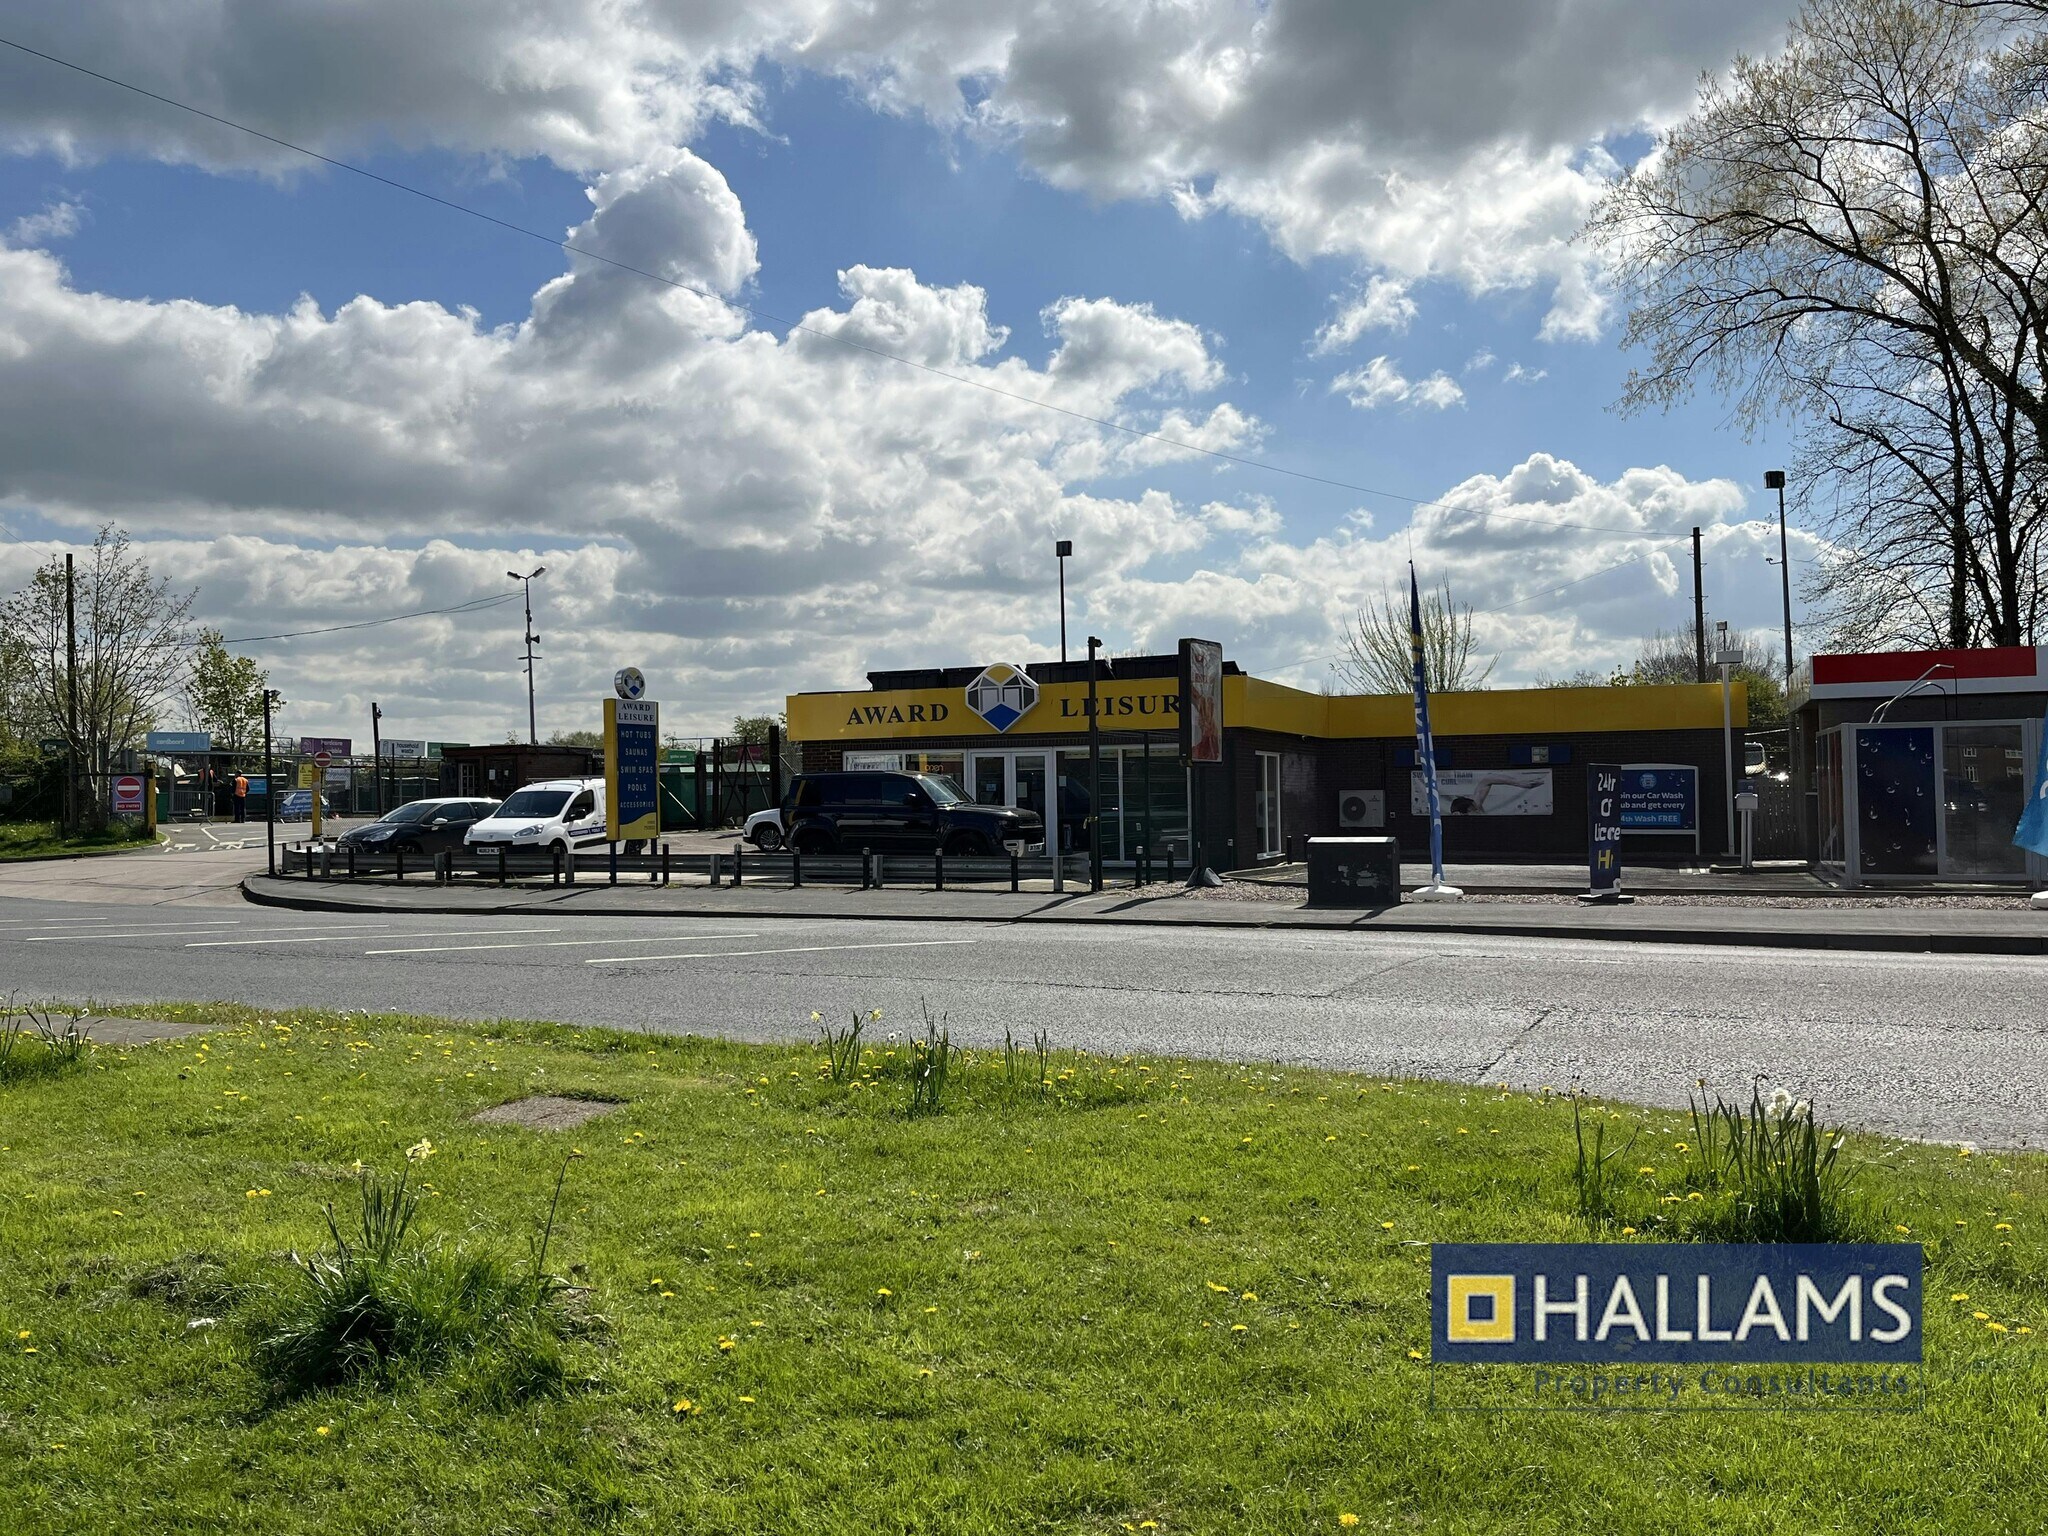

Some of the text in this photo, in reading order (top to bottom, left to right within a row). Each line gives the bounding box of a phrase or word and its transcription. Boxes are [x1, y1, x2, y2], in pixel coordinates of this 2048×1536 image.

[621, 703, 651, 711] AWARD
[847, 694, 1180, 726] AWARD LEISUR
[618, 712, 655, 722] LEISURE
[620, 730, 652, 739] HOT TUBS
[625, 748, 648, 756] SAUNAS
[620, 765, 654, 774] SWIM SPAS
[627, 783, 647, 792] POOLS
[1661, 791, 1684, 799] Wash
[620, 801, 655, 809] ACCESSORIES
[1631, 801, 1647, 809] and
[1647, 802, 1662, 810] get
[1662, 802, 1686, 810] every
[1634, 814, 1657, 822] Wash
